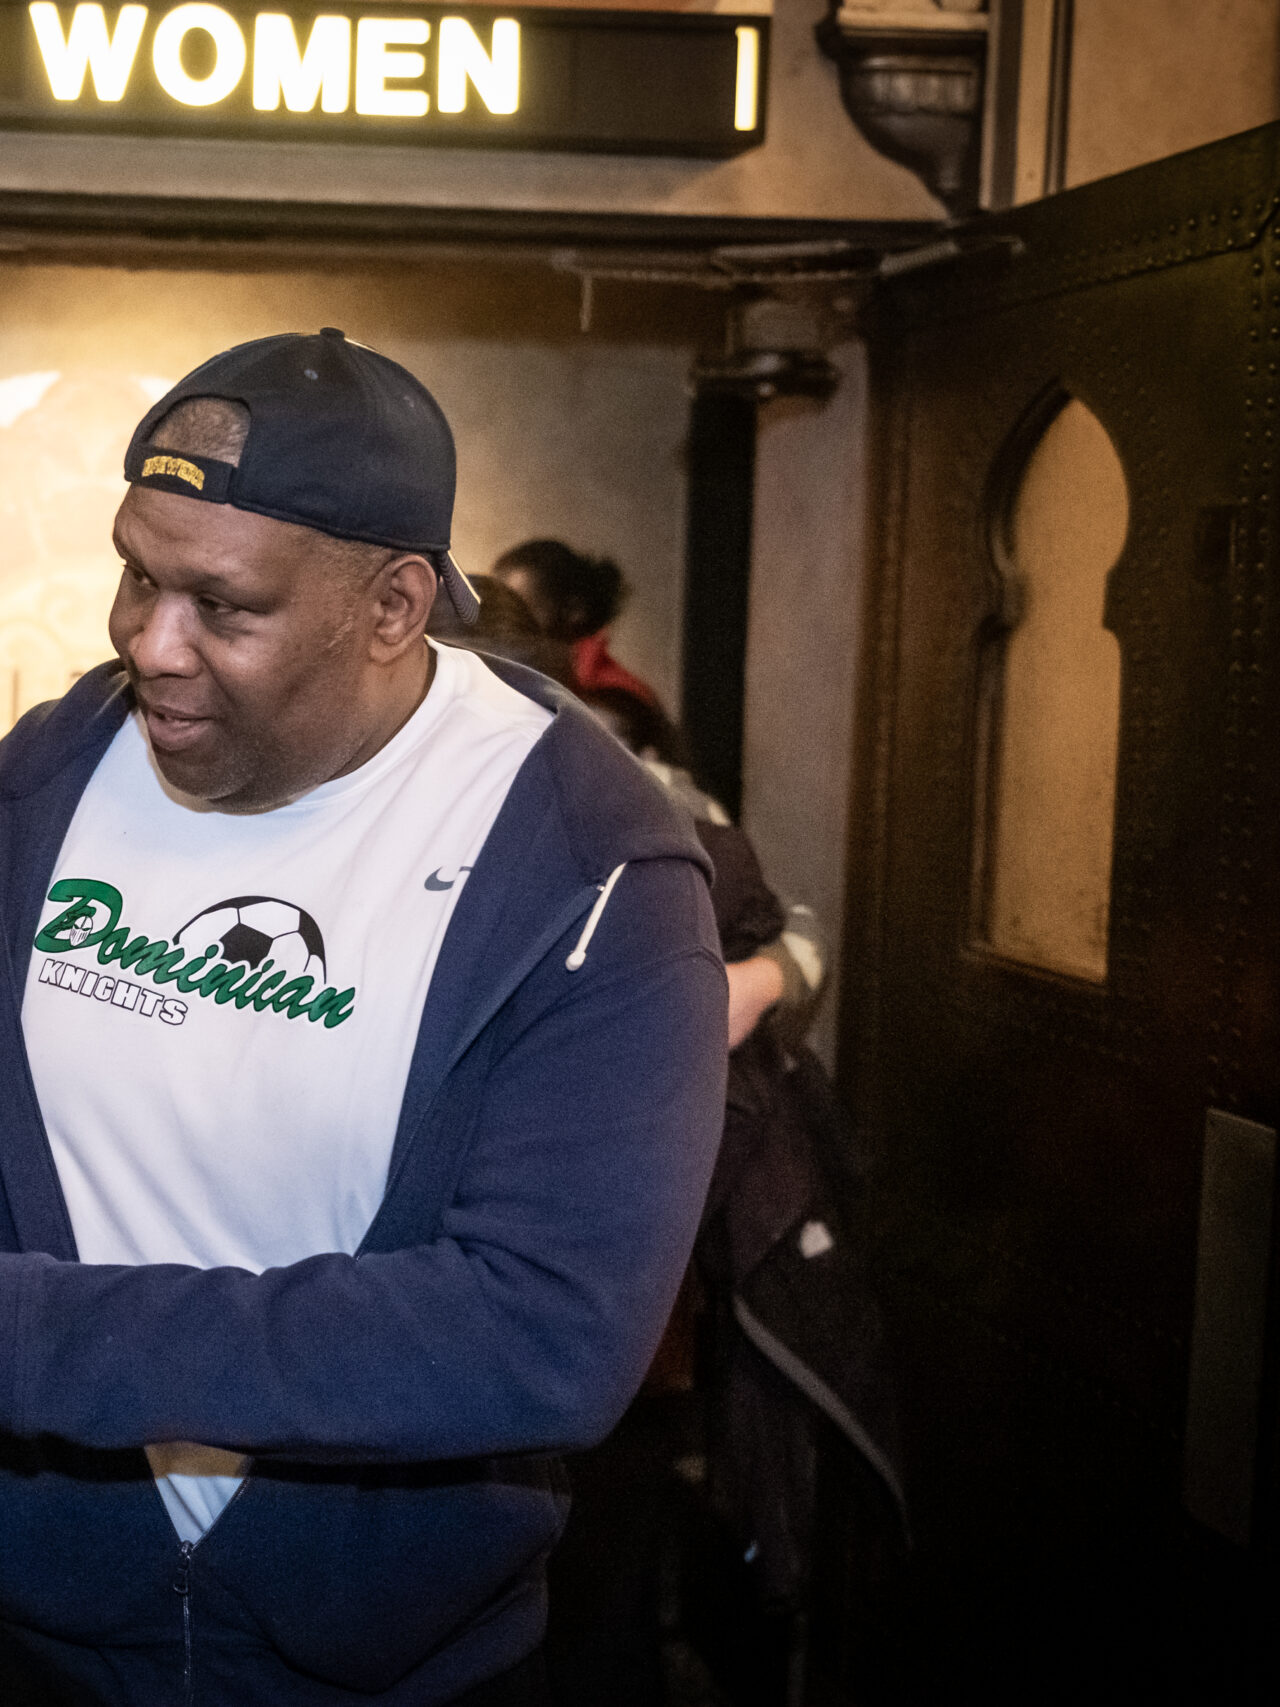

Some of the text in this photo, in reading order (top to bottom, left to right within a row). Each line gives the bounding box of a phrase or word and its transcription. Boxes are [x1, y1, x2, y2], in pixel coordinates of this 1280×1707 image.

[28, 1, 520, 117] WOMEN
[34, 878, 355, 1029] Dominican
[38, 958, 189, 1026] KNIGHTS
